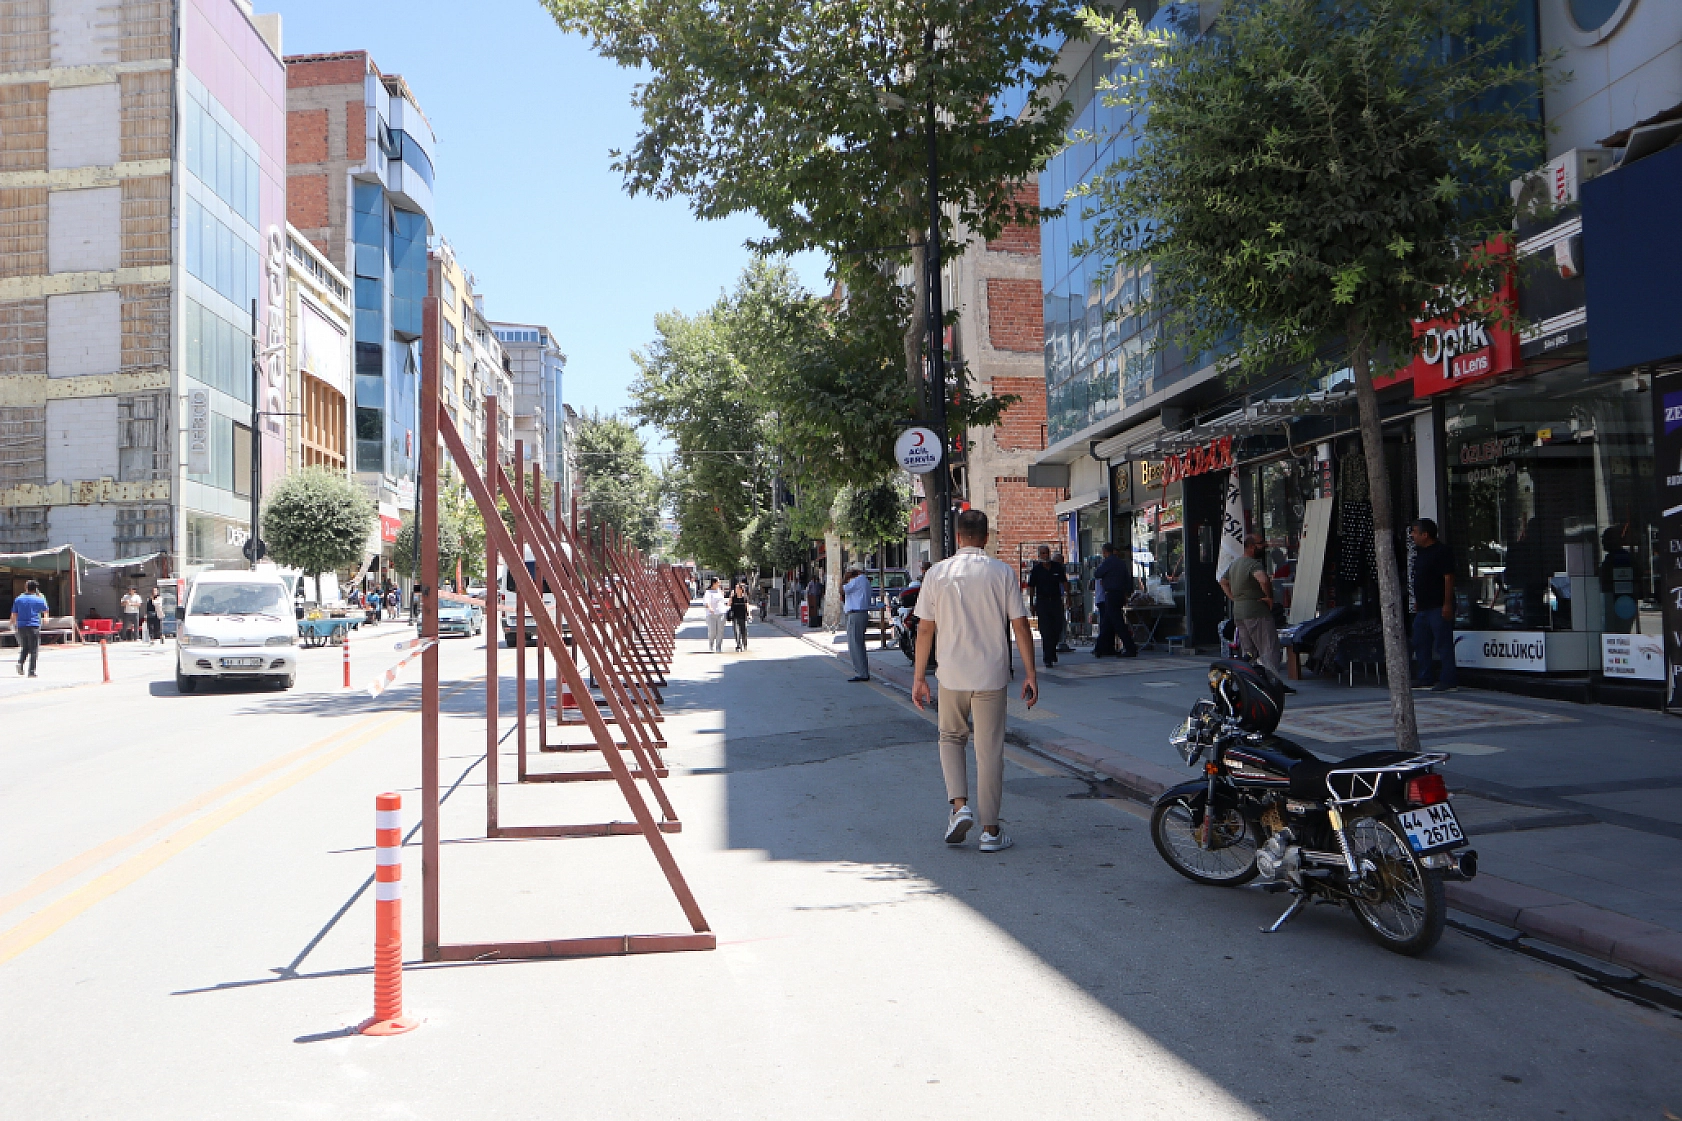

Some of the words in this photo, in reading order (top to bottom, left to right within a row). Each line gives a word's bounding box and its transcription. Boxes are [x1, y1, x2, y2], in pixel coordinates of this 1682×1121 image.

[1462, 355, 1488, 375] Lens
[904, 454, 936, 465] SERVİS
[1483, 638, 1544, 663] GÖZLÜKÇÜ
[1403, 812, 1423, 831] 44
[1427, 805, 1453, 824] MA
[1423, 822, 1461, 846] 2676
